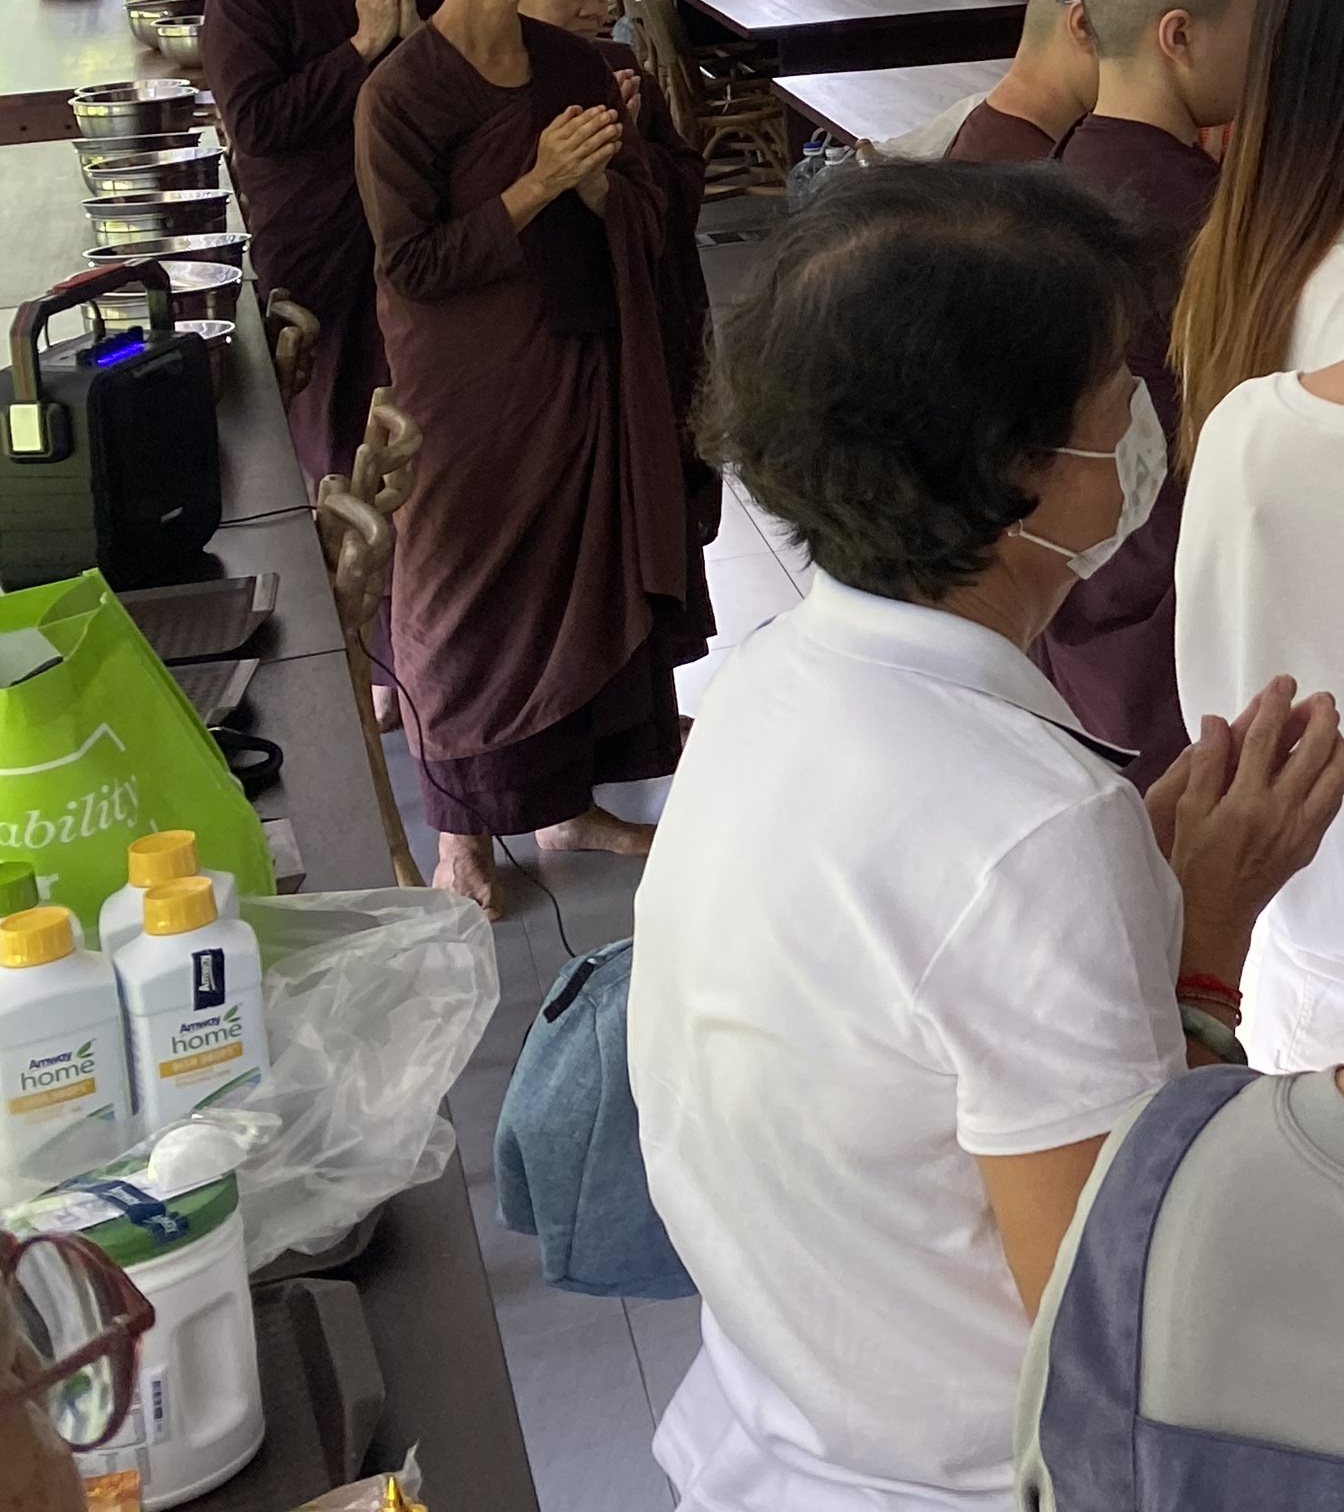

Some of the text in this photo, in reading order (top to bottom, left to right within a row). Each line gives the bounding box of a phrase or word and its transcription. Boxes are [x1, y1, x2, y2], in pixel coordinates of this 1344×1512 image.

[179, 1016, 221, 1034] Amway
[172, 1023, 243, 1054] home
[29, 1051, 73, 1070] Amway
[20, 1059, 95, 1091] home
